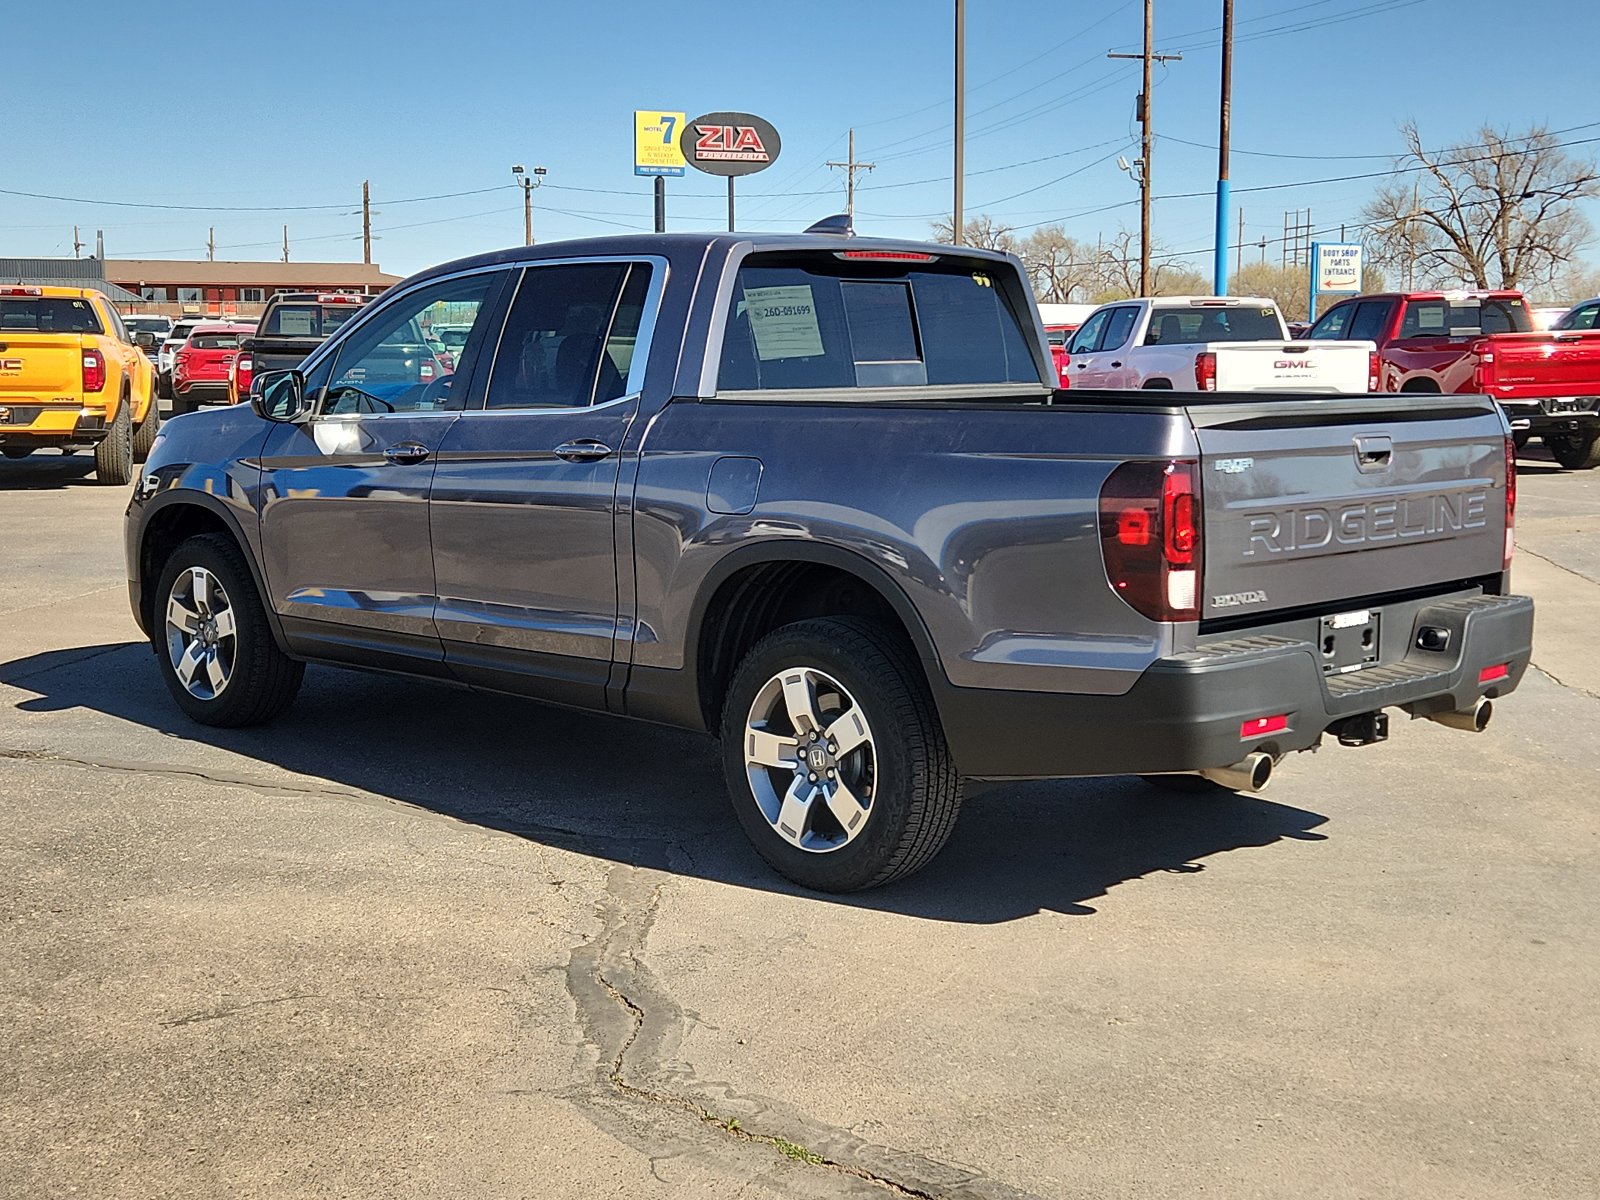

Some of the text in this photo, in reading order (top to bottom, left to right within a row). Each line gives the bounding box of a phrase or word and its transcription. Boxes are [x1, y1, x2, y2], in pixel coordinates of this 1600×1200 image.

[660, 116, 677, 144] 7
[694, 124, 766, 152] ZIA
[1341, 249, 1358, 257] SHOP
[1274, 360, 1316, 369] GMC
[1242, 492, 1486, 556] RIDGELINE
[1211, 590, 1268, 608] HONDA
